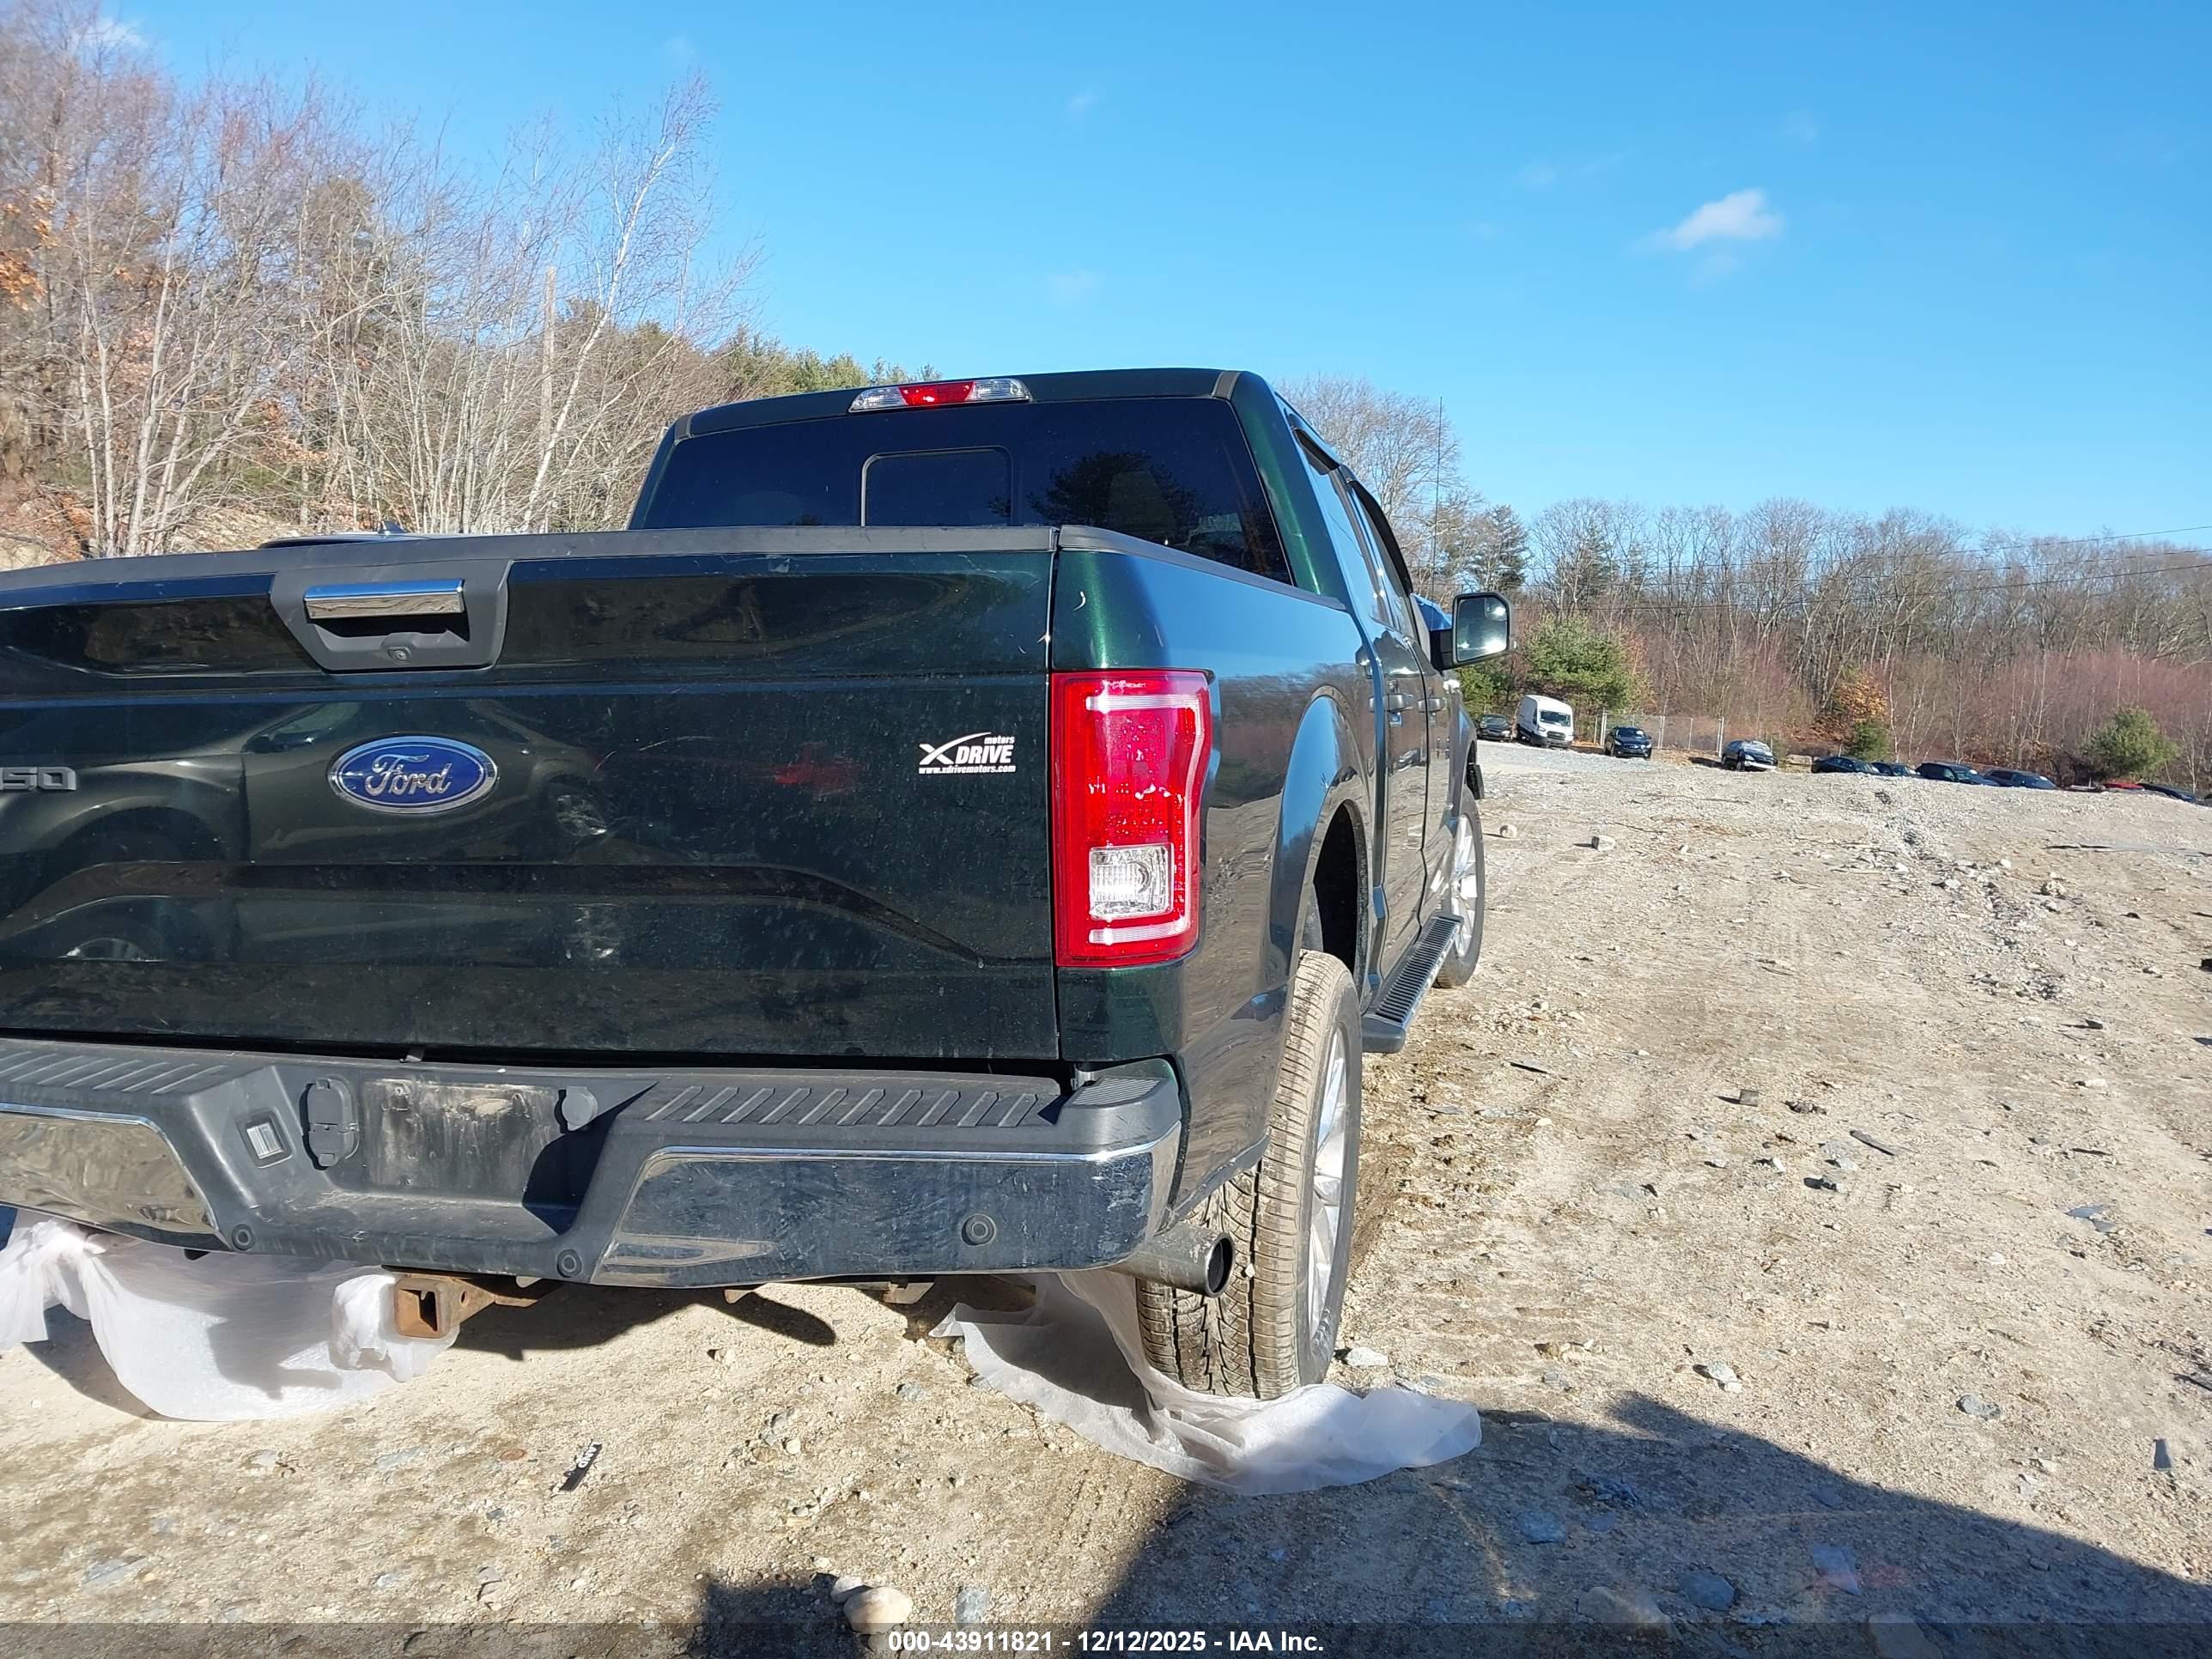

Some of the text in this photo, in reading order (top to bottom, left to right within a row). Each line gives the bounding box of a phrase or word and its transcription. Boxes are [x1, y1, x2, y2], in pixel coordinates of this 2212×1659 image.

[984, 735, 1015, 744] motors
[0, 766, 76, 791] 50
[364, 753, 454, 797] Ford
[918, 764, 1017, 775] www.xdrivemotors.com
